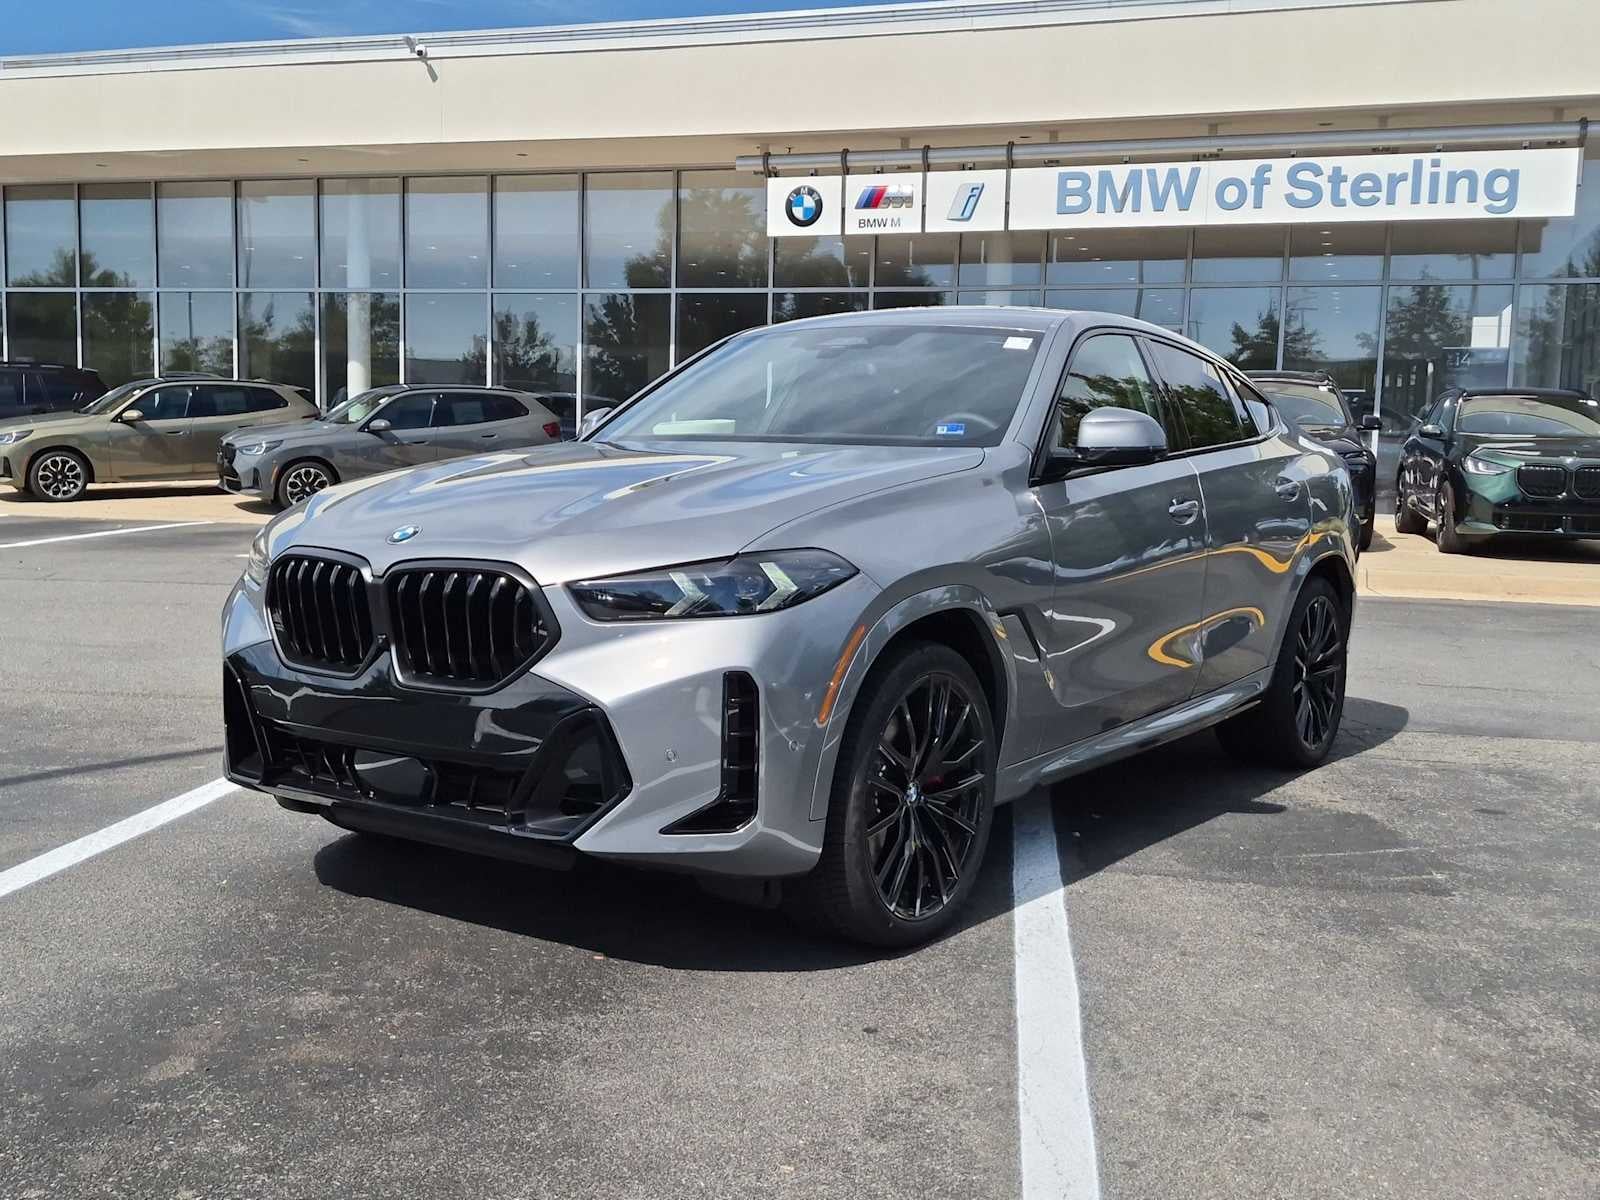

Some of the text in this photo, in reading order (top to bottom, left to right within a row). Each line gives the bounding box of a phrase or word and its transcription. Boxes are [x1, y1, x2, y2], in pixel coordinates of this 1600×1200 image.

[1056, 158, 1520, 214] BMW of Sterling
[858, 217, 901, 229] BMW M
